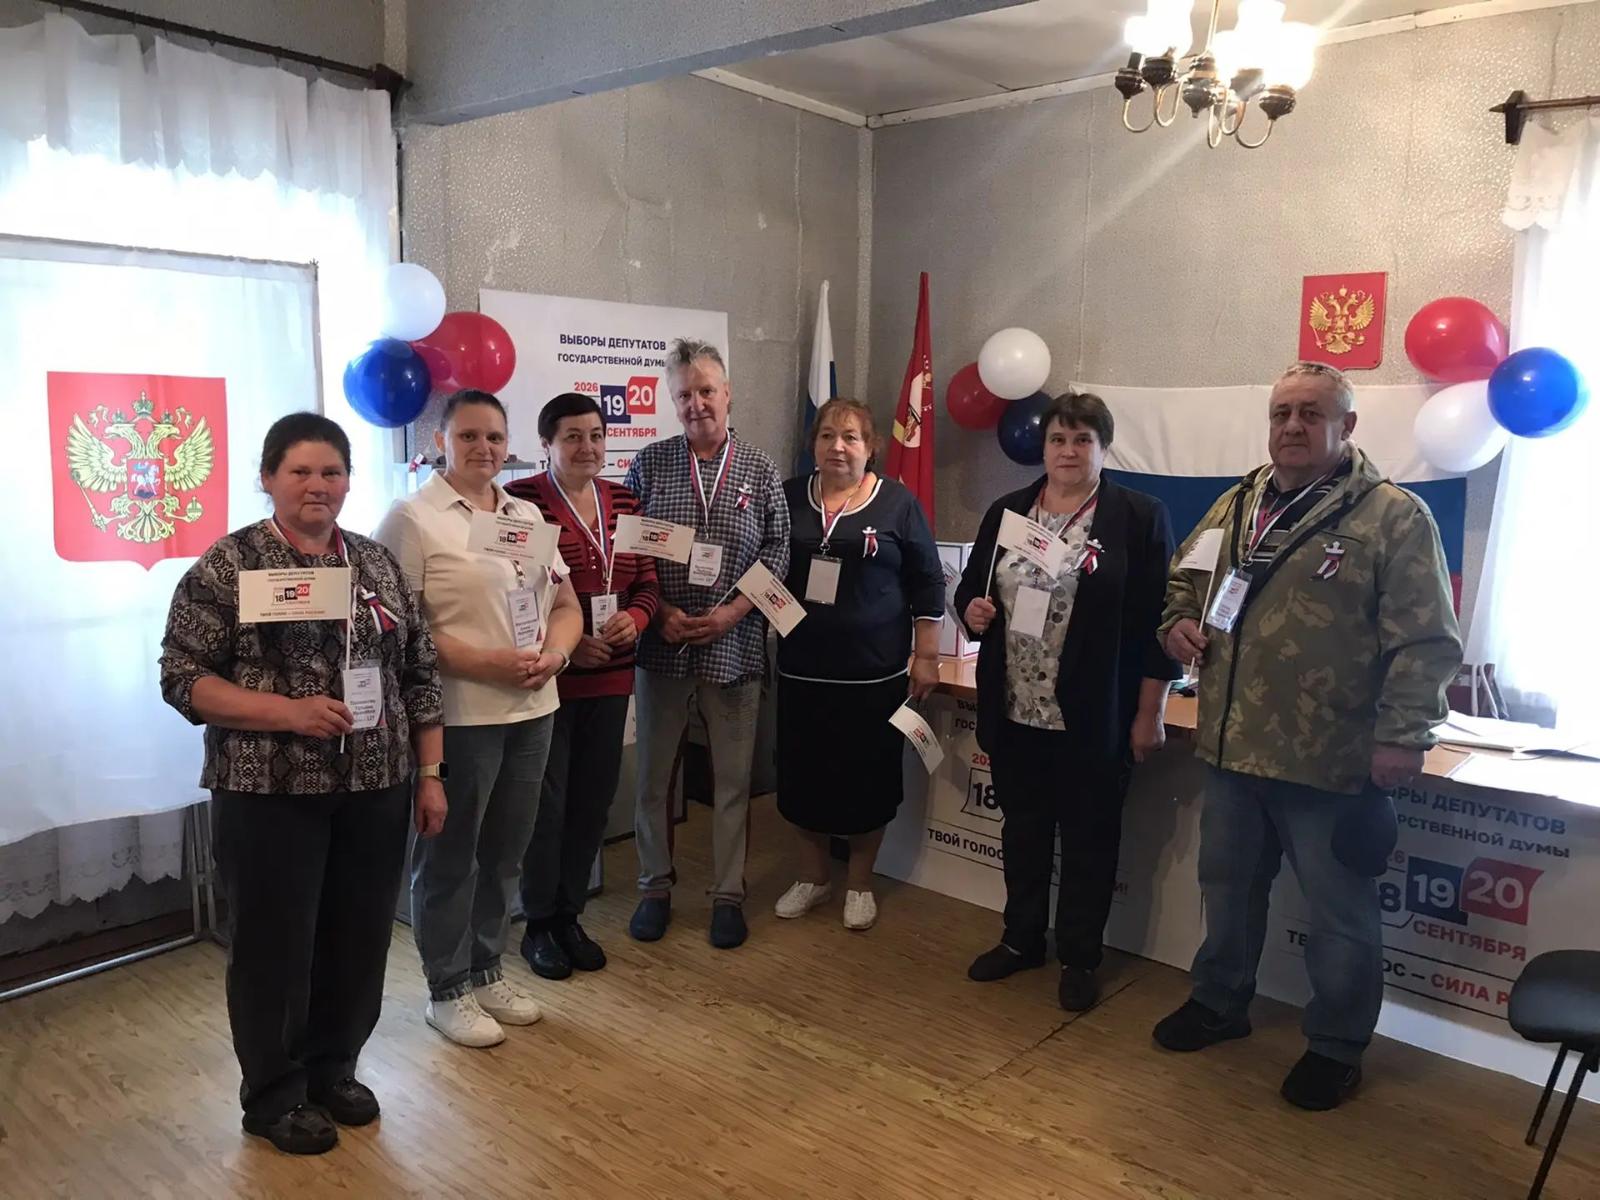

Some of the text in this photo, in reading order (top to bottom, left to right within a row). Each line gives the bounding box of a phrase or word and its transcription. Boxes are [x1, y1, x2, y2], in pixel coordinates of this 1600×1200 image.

[560, 334, 666, 350] ВЫБОРЫ ДЕПУТАТОВ
[558, 353, 642, 366] ГОСУДАРСТВЕННОЙ
[574, 382, 599, 392] 2026
[603, 385, 653, 416] 19 20
[607, 427, 657, 438] СЕНТЯБРЯ
[971, 752, 990, 766] 20
[973, 782, 1000, 810] 18
[1432, 793, 1566, 835] ДЕПУТАТОВ
[928, 828, 960, 847] ТВОЙ
[1509, 838, 1570, 858] ДУМЫ
[1413, 873, 1456, 908] 19
[1467, 870, 1524, 910] 20
[1413, 920, 1526, 961] СЕНТЯБРЯ
[1431, 973, 1490, 1001] СИЛА
